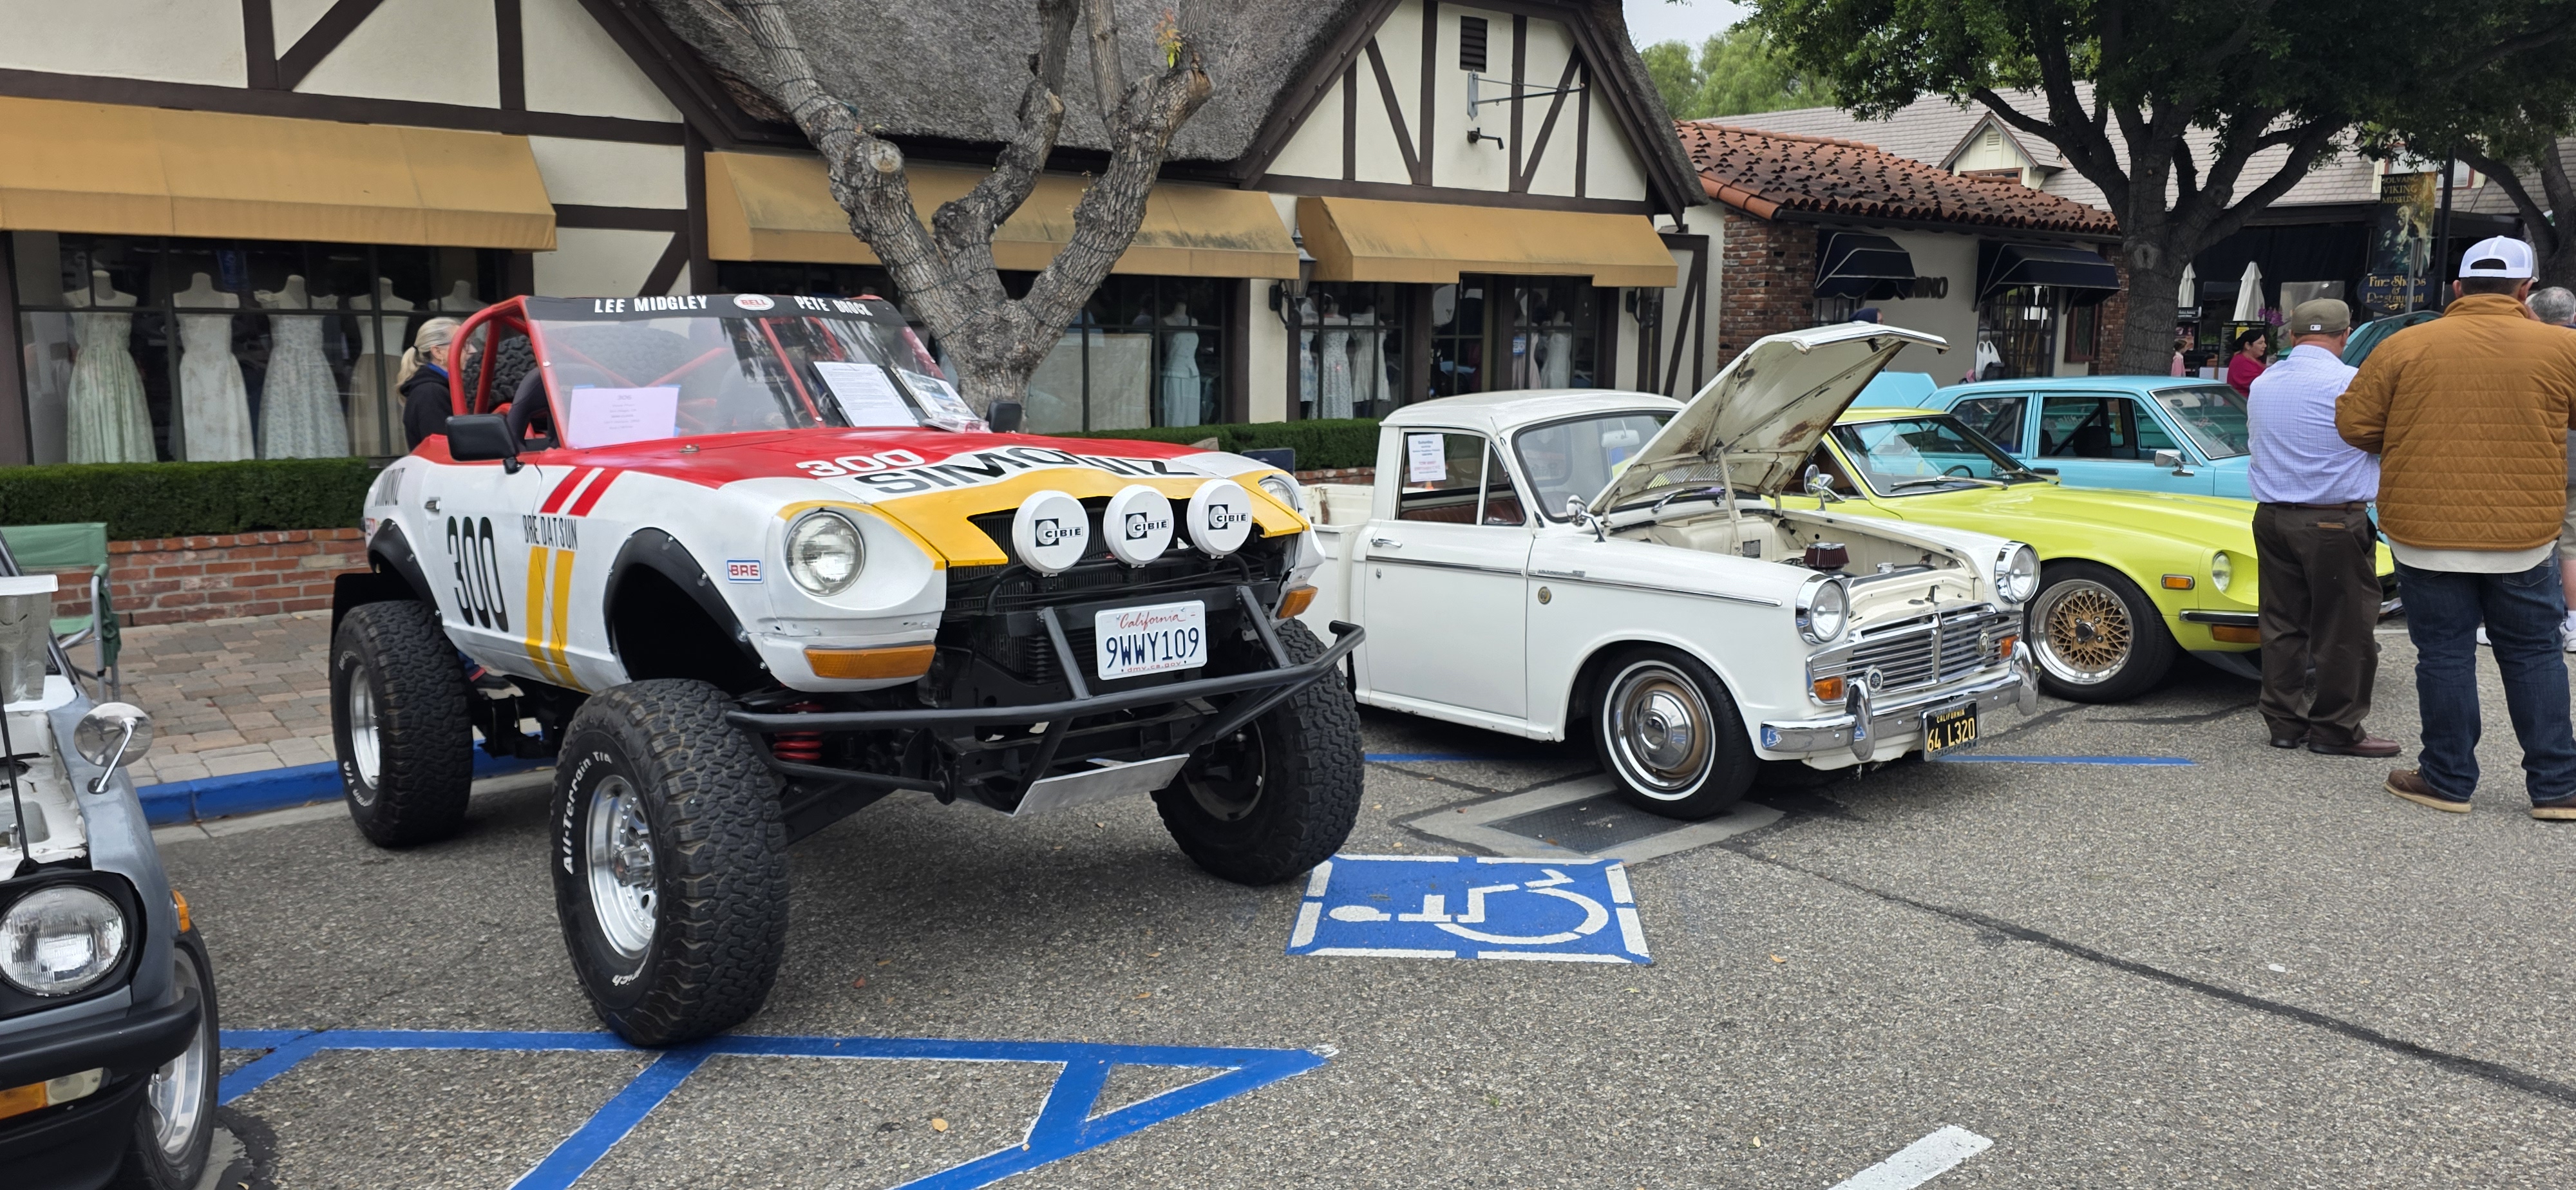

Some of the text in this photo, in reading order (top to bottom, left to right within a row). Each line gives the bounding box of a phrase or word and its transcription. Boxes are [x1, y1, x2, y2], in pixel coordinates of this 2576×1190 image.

[2382, 175, 2418, 184] SOLVANG
[2383, 184, 2418, 194] VIKING
[2382, 195, 2417, 203] MUSEUM
[594, 295, 707, 313] LEE MIDGLEY
[793, 295, 873, 317] PETE BROCK
[796, 449, 925, 477] 300
[522, 515, 578, 550] BRE DATSUN
[446, 516, 509, 632] 300
[728, 565, 759, 576] BRE
[1119, 611, 1186, 632] California
[1106, 627, 1200, 669] 9WWY109
[1127, 661, 1182, 674] dmv.ca.gov
[1936, 708, 1965, 724] CALIFORNIA
[1927, 717, 1976, 753] 64 L320
[563, 751, 612, 875] All-Terrain T/A
